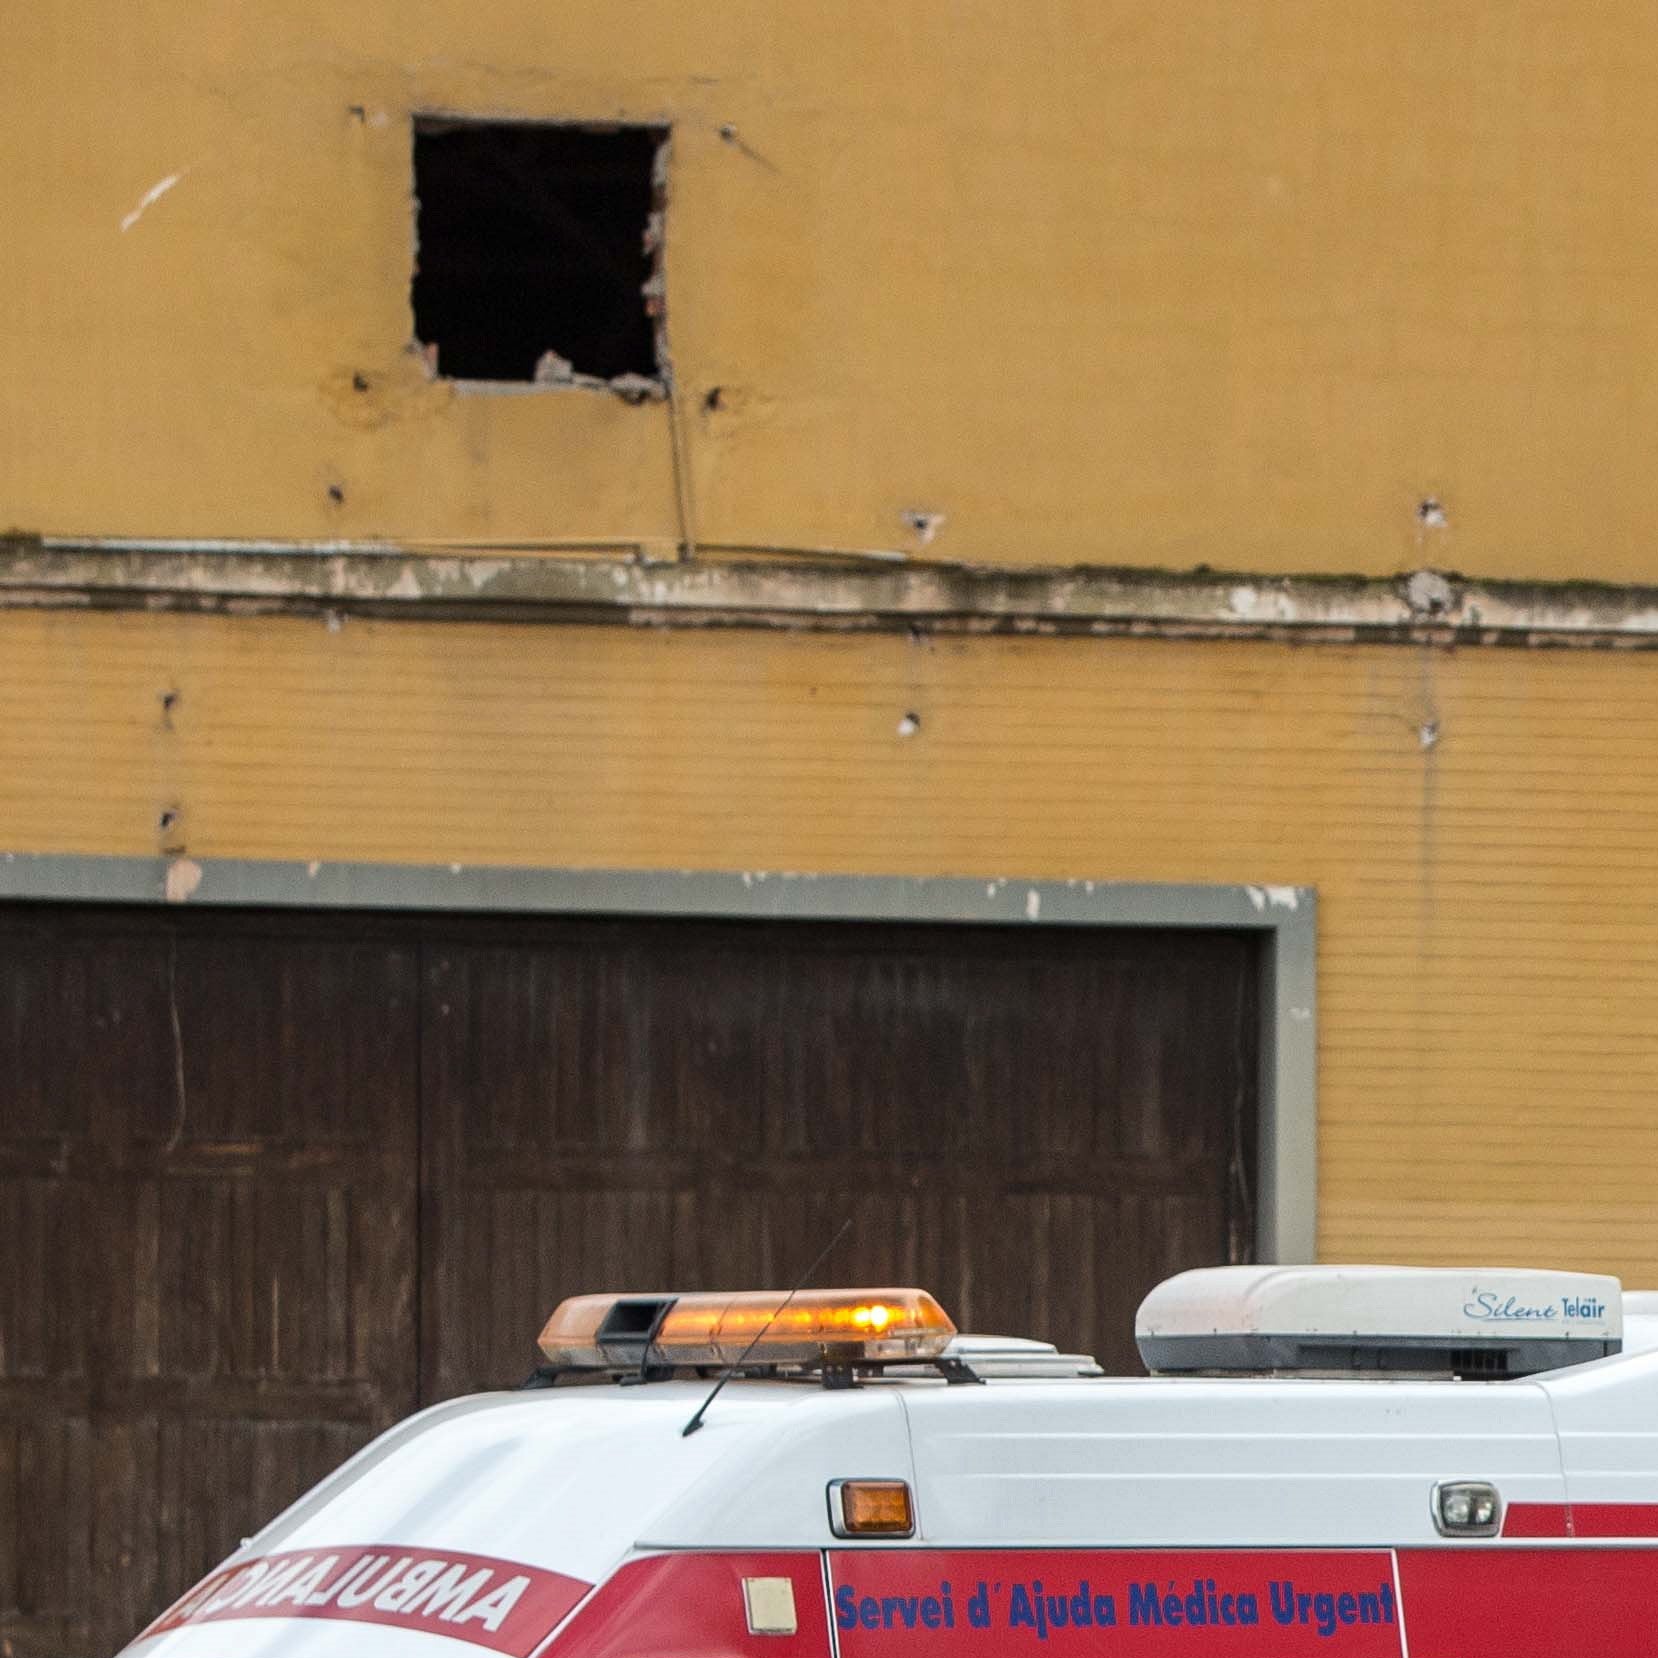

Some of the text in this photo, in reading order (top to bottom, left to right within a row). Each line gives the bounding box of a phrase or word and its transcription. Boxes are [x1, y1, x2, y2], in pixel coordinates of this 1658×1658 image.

[1463, 1292, 1558, 1319] Silent
[836, 1580, 954, 1629] Servei
[1128, 1578, 1258, 1626] Médica
[1269, 1580, 1394, 1638] Urgent
